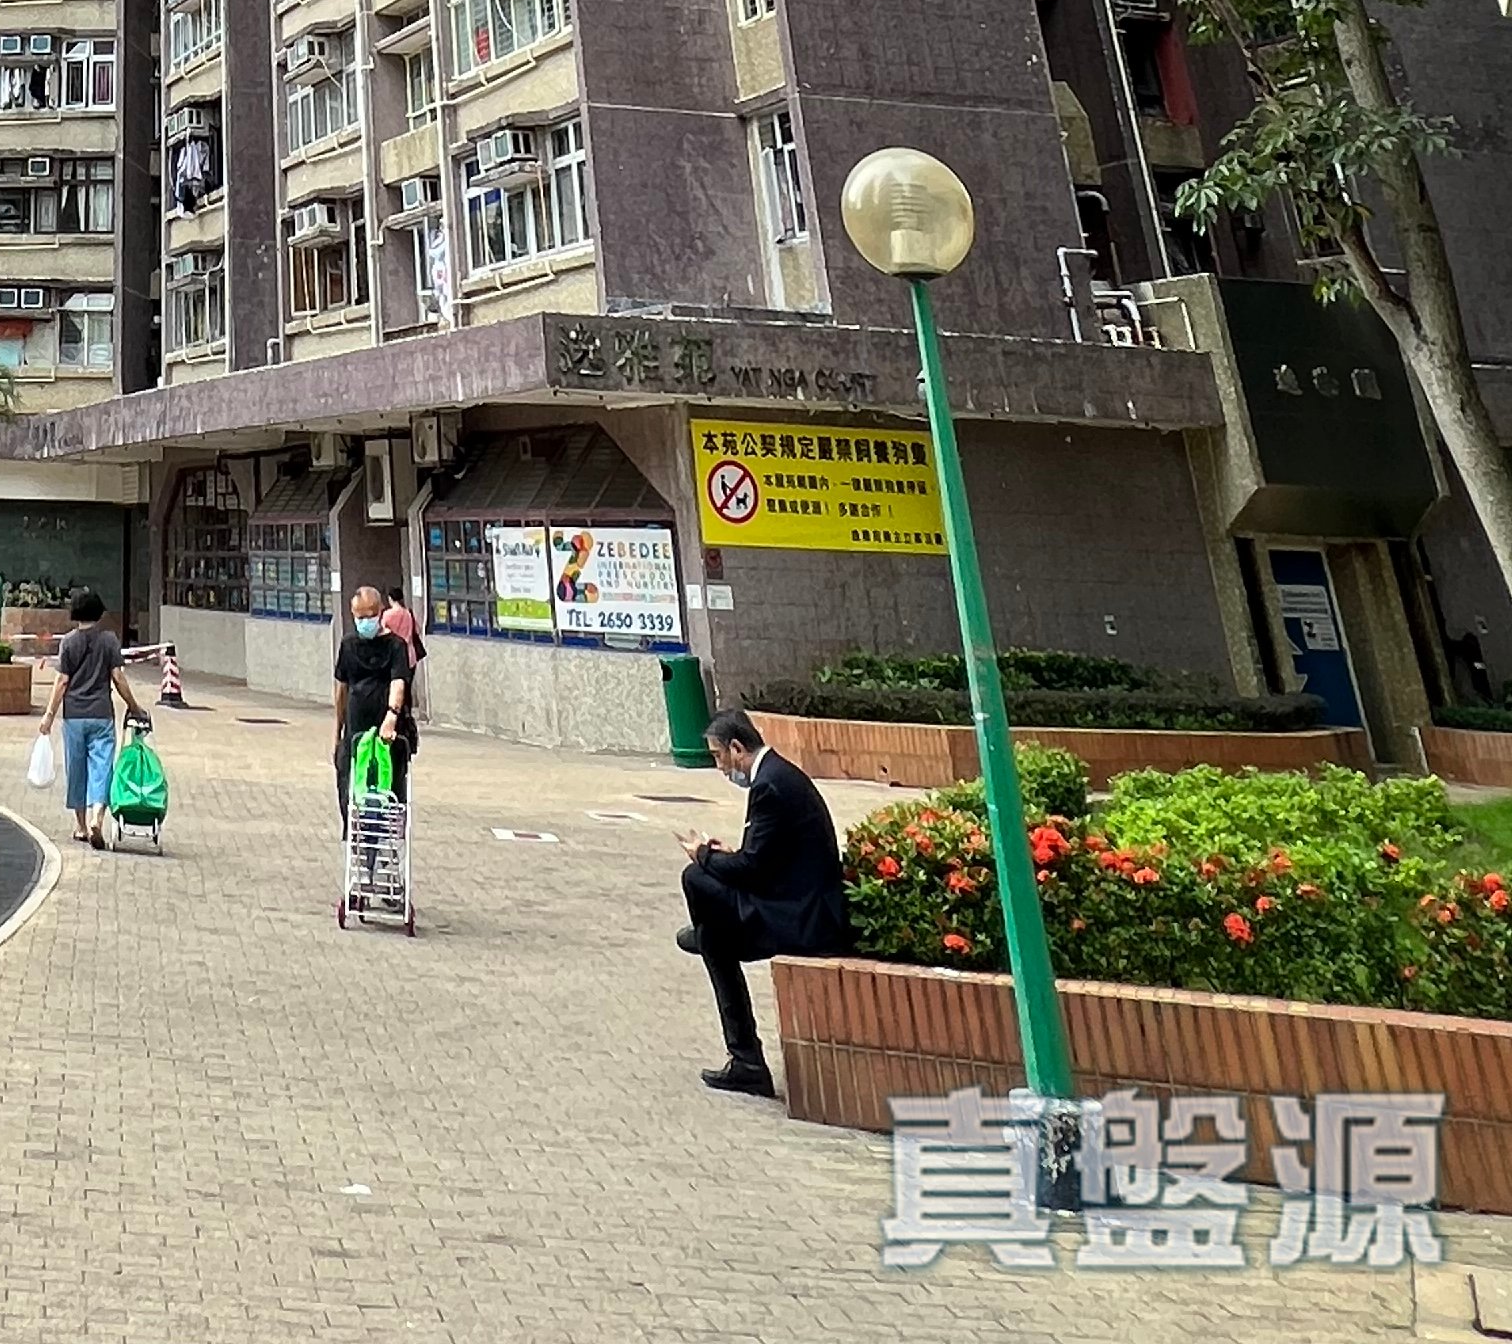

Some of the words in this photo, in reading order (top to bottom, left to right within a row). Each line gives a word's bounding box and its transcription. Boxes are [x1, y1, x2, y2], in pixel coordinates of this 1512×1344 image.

[730, 365, 762, 388] YAT
[768, 368, 809, 390] NGA
[597, 541, 671, 559] ZEBEDEE
[598, 611, 633, 629] 2650
[638, 613, 674, 631] 3339
